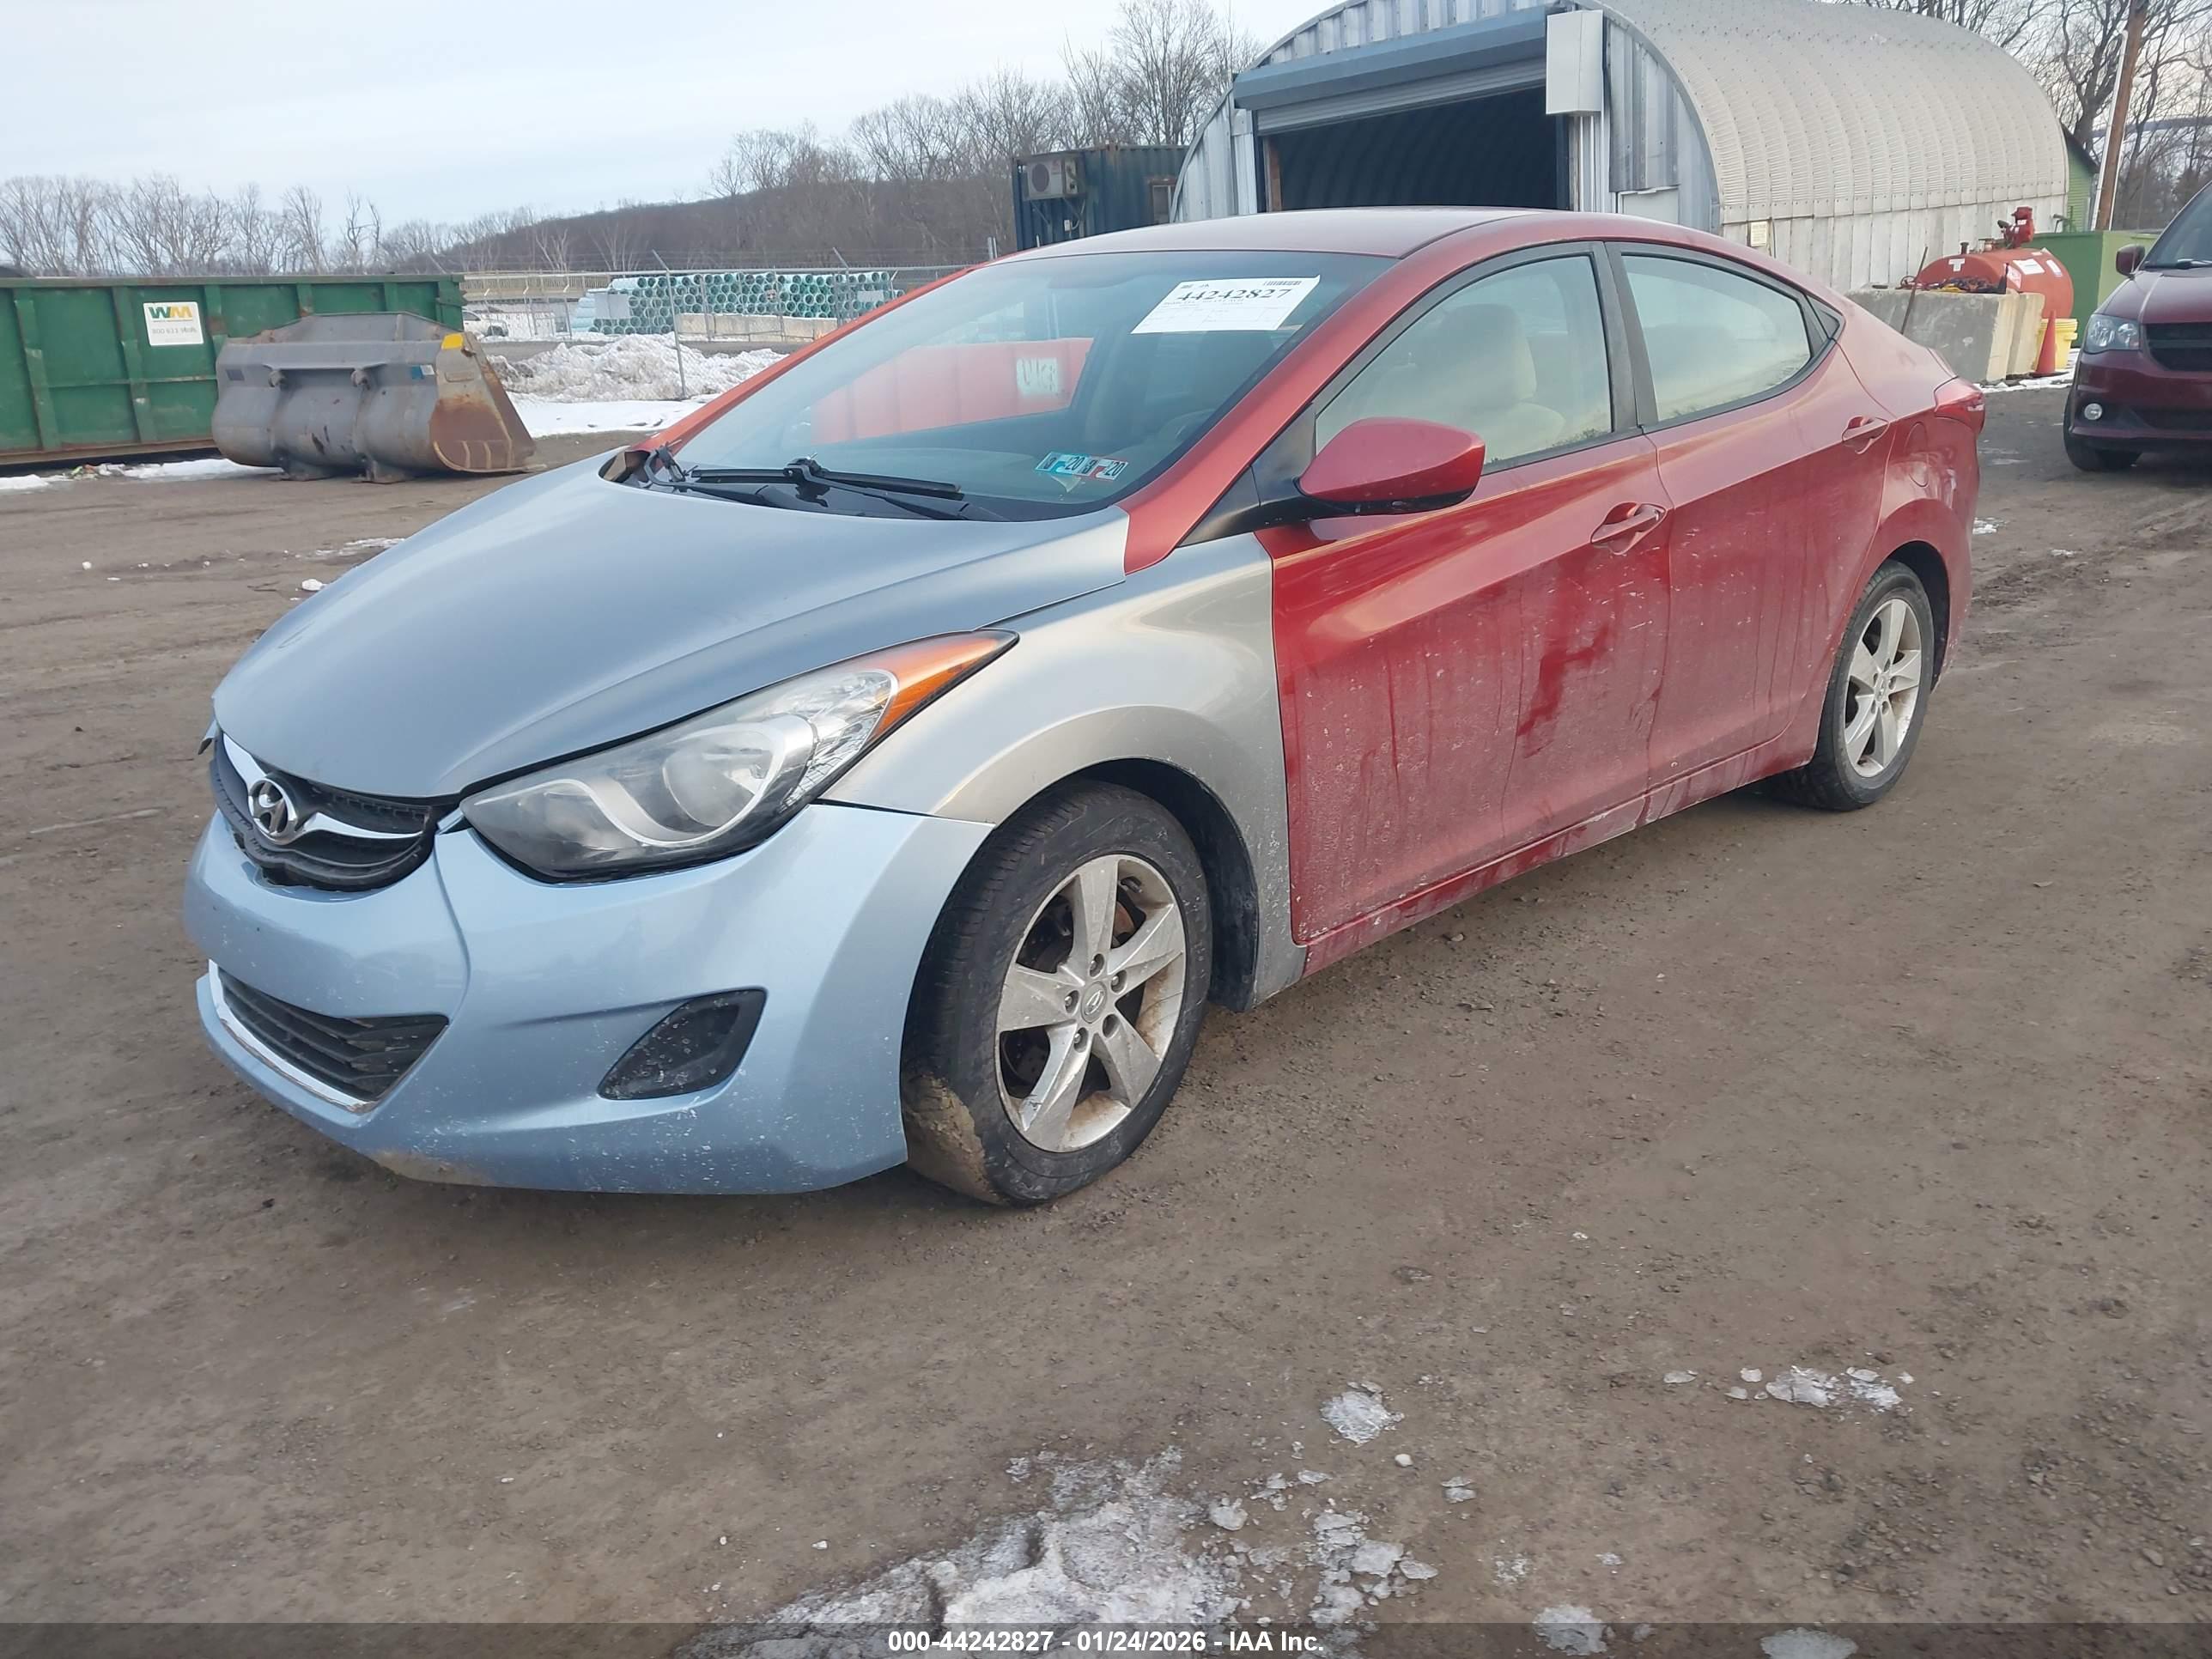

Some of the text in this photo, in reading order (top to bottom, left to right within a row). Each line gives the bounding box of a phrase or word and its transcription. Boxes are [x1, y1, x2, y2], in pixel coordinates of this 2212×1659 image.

[1176, 289, 1291, 301] 44242827
[149, 306, 192, 319] WM
[1065, 456, 1085, 471] 20
[1104, 461, 1125, 477] 20
